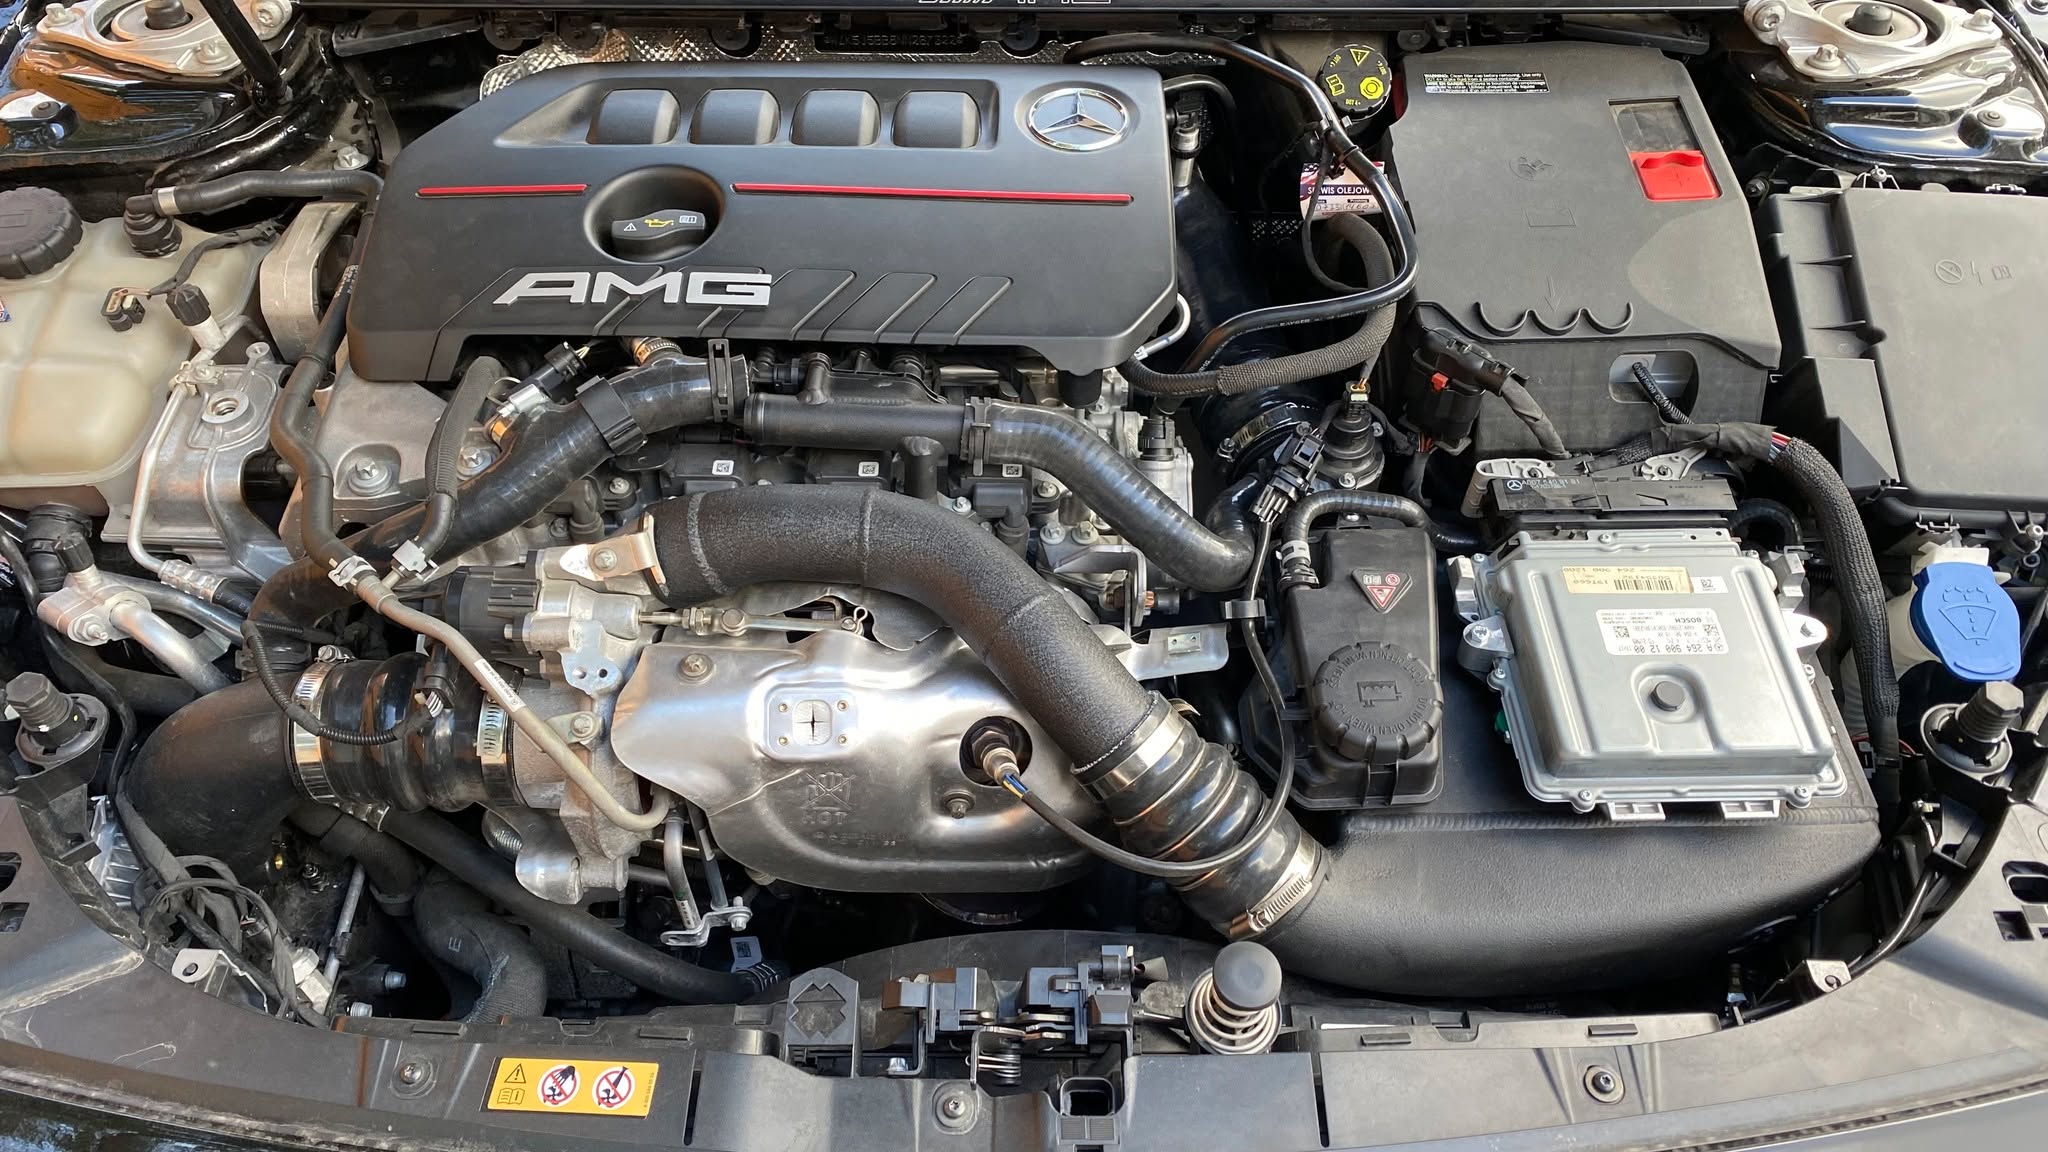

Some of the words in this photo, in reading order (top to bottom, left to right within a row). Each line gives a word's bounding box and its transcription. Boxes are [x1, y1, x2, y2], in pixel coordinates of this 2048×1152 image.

[493, 272, 773, 306] AMG
[1650, 645, 1660, 653] 12
[1665, 644, 1681, 653] 900
[1686, 644, 1702, 652] 264
